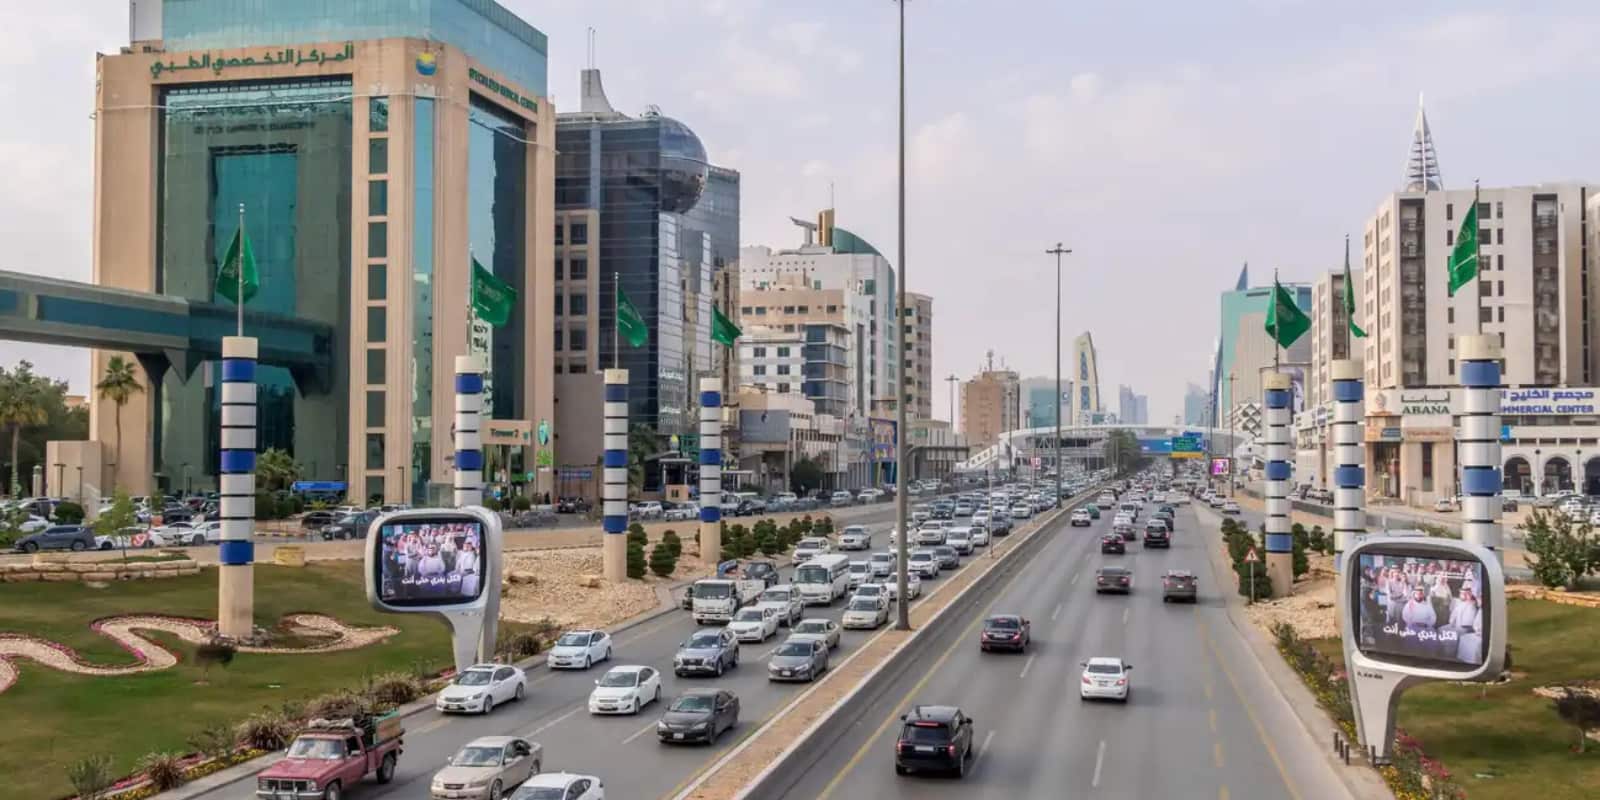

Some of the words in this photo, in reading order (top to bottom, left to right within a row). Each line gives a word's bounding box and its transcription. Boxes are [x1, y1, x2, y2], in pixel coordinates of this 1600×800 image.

[295, 42, 354, 67] المركز
[150, 53, 211, 79] الطبي
[212, 49, 294, 75] التخصصي
[1511, 390, 1550, 401] الخليج
[1552, 391, 1594, 401] مجمع
[1402, 405, 1450, 415] ABANA
[1502, 405, 1553, 413] MMERCIAL
[1556, 405, 1594, 413] CENTER
[1383, 622, 1399, 634] أنت
[1438, 631, 1458, 640] الكل
